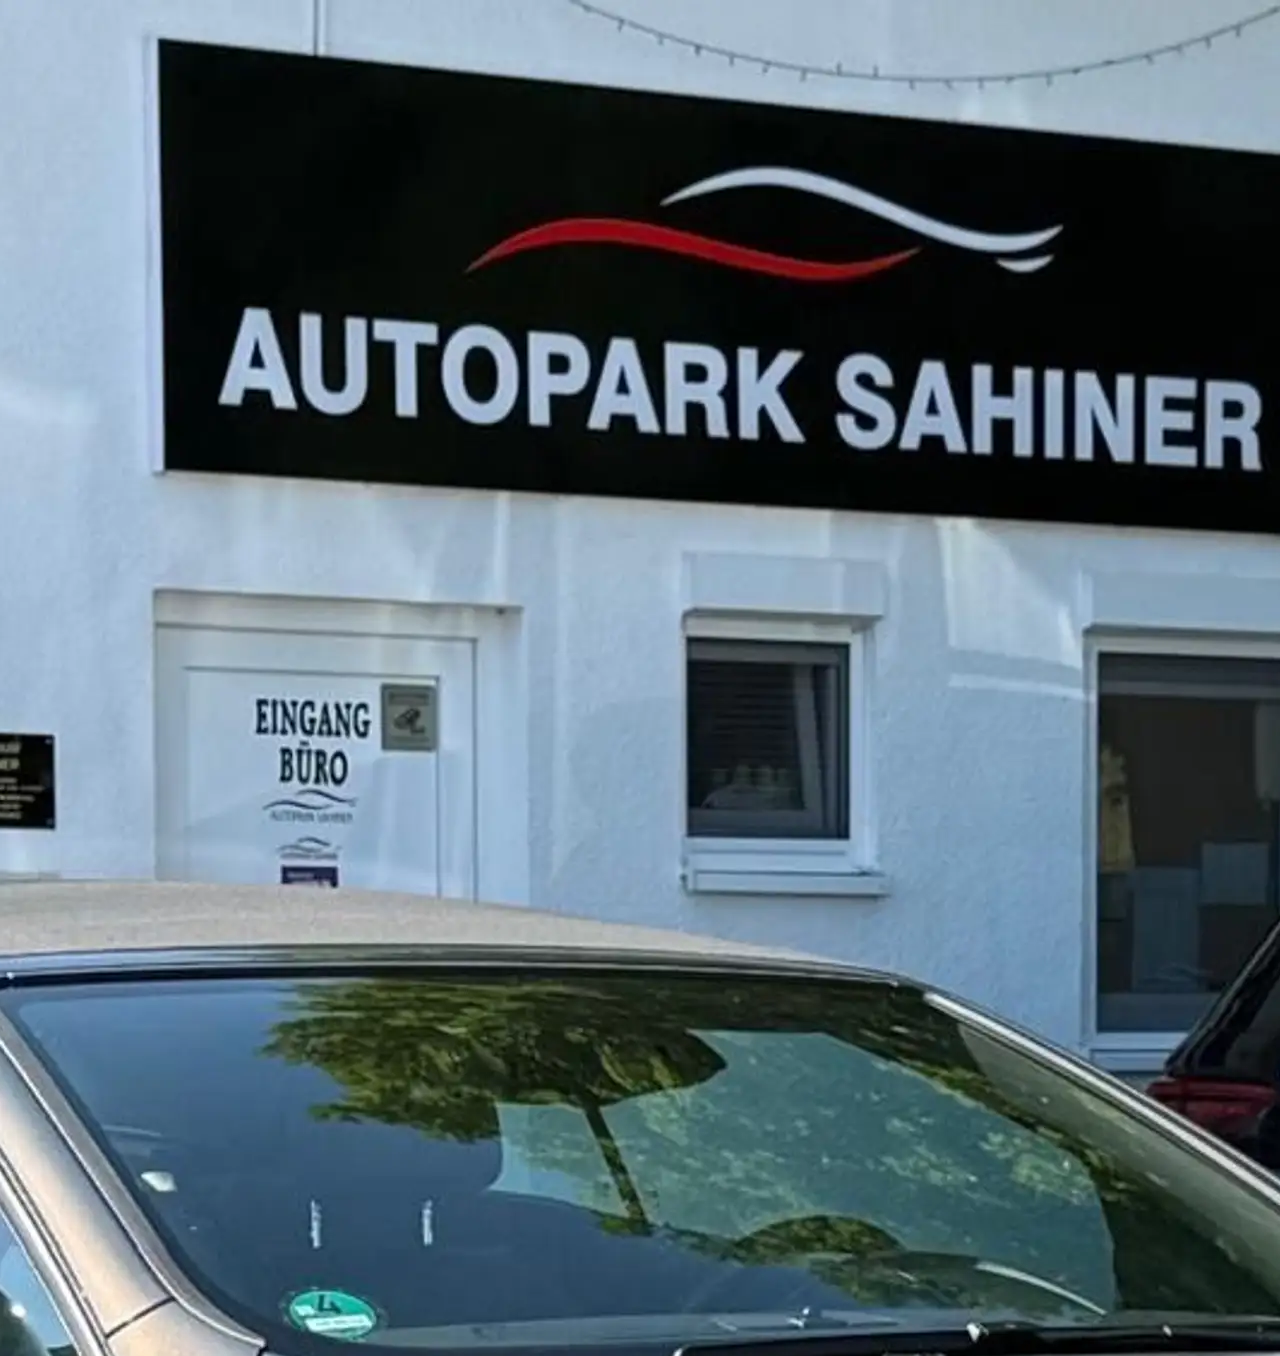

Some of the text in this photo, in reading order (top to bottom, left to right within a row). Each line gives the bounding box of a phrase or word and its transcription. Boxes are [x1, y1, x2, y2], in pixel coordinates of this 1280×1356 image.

[219, 306, 1264, 472] AUTOPARK SAHINER
[255, 697, 371, 738] EINGANG
[278, 740, 349, 786] BÜRO
